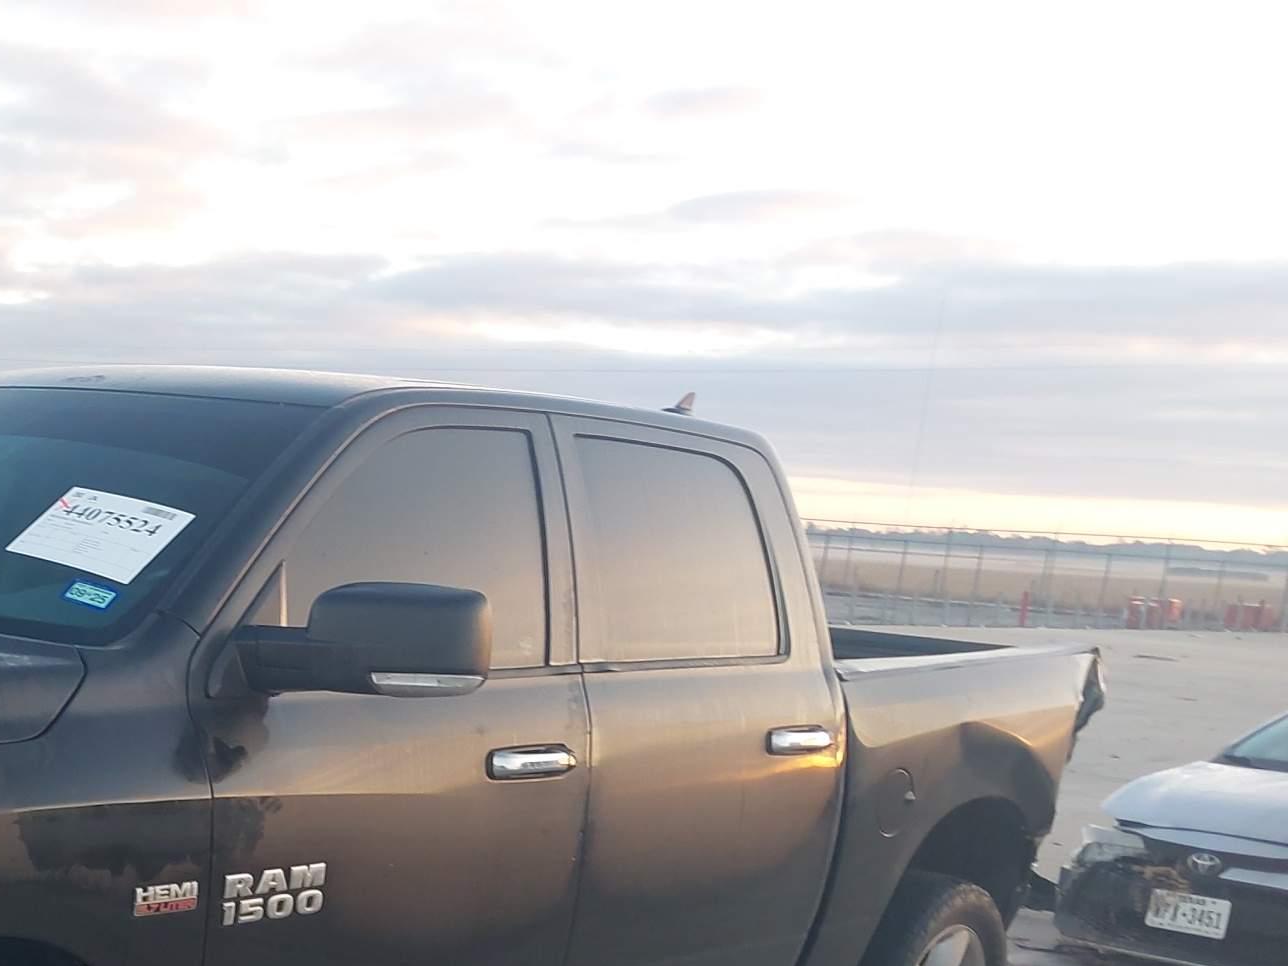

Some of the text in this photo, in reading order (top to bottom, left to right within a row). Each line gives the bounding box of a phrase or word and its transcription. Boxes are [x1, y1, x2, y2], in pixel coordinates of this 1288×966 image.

[63, 504, 163, 536] 44075524
[135, 880, 199, 904] HEMI
[224, 862, 327, 899] RAM
[222, 889, 324, 926] 1500
